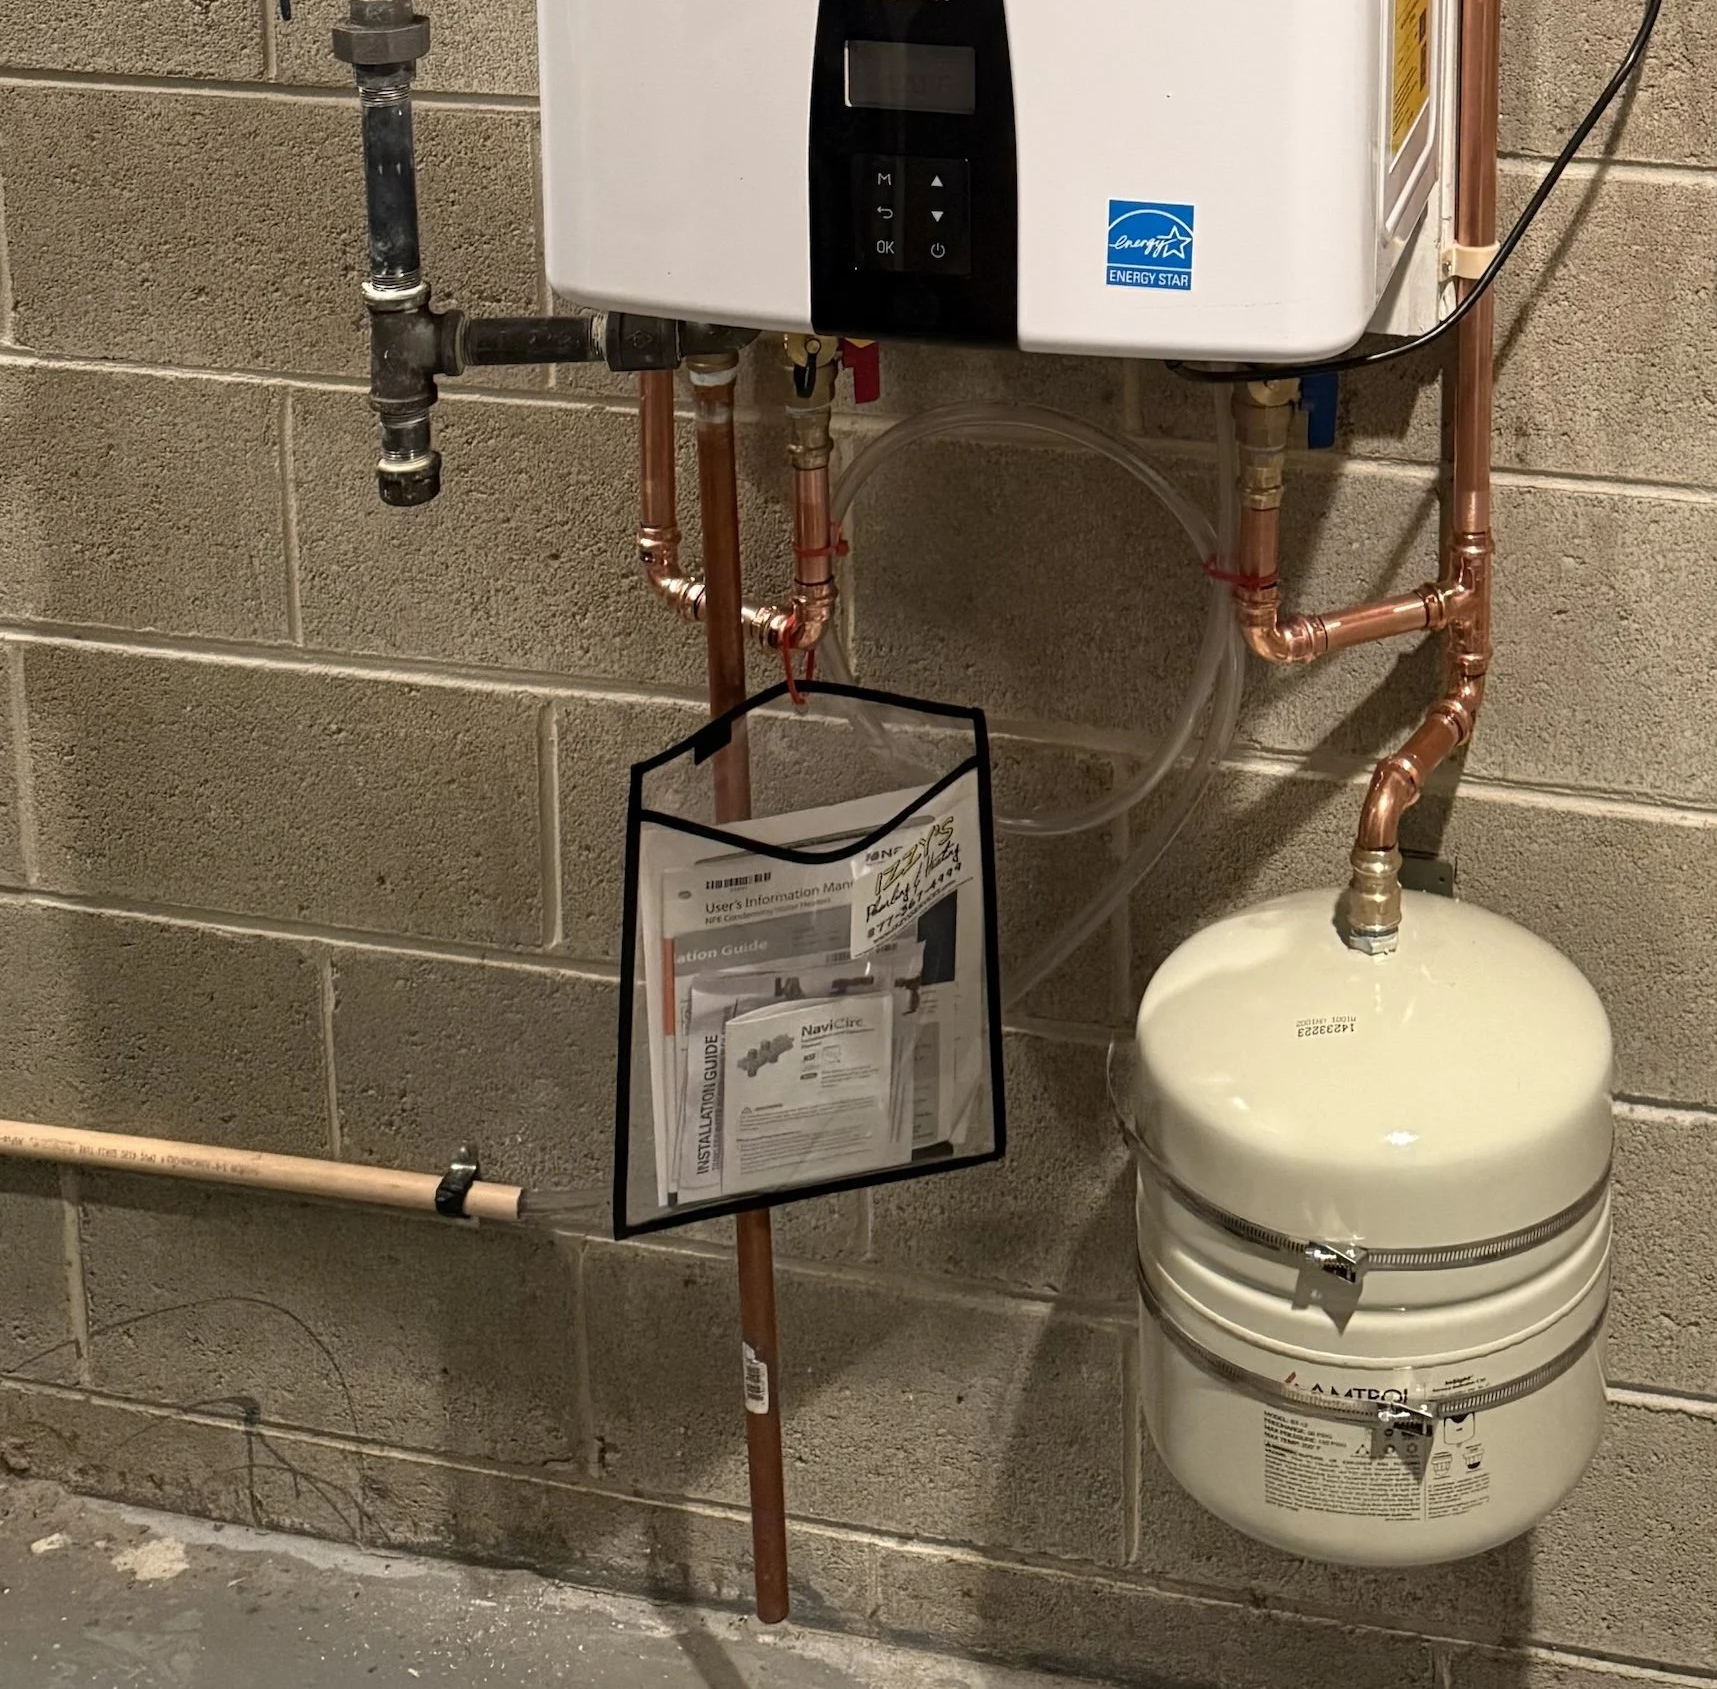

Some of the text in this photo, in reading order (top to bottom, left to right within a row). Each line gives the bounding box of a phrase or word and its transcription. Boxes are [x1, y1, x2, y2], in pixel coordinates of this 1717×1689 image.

[877, 172, 892, 187] M
[876, 240, 895, 255] OK
[1109, 233, 1167, 258] energy
[1109, 269, 1189, 288] ENERGY STAR
[875, 815, 954, 897] IZZY'S
[705, 899, 743, 915] User's
[744, 887, 821, 909] Information
[721, 939, 769, 956] Guide
[801, 1016, 864, 1037] NaviCirc
[1297, 1023, 1355, 1038] 14233223
[696, 1034, 719, 1175] INSTALLATION GUIDE
